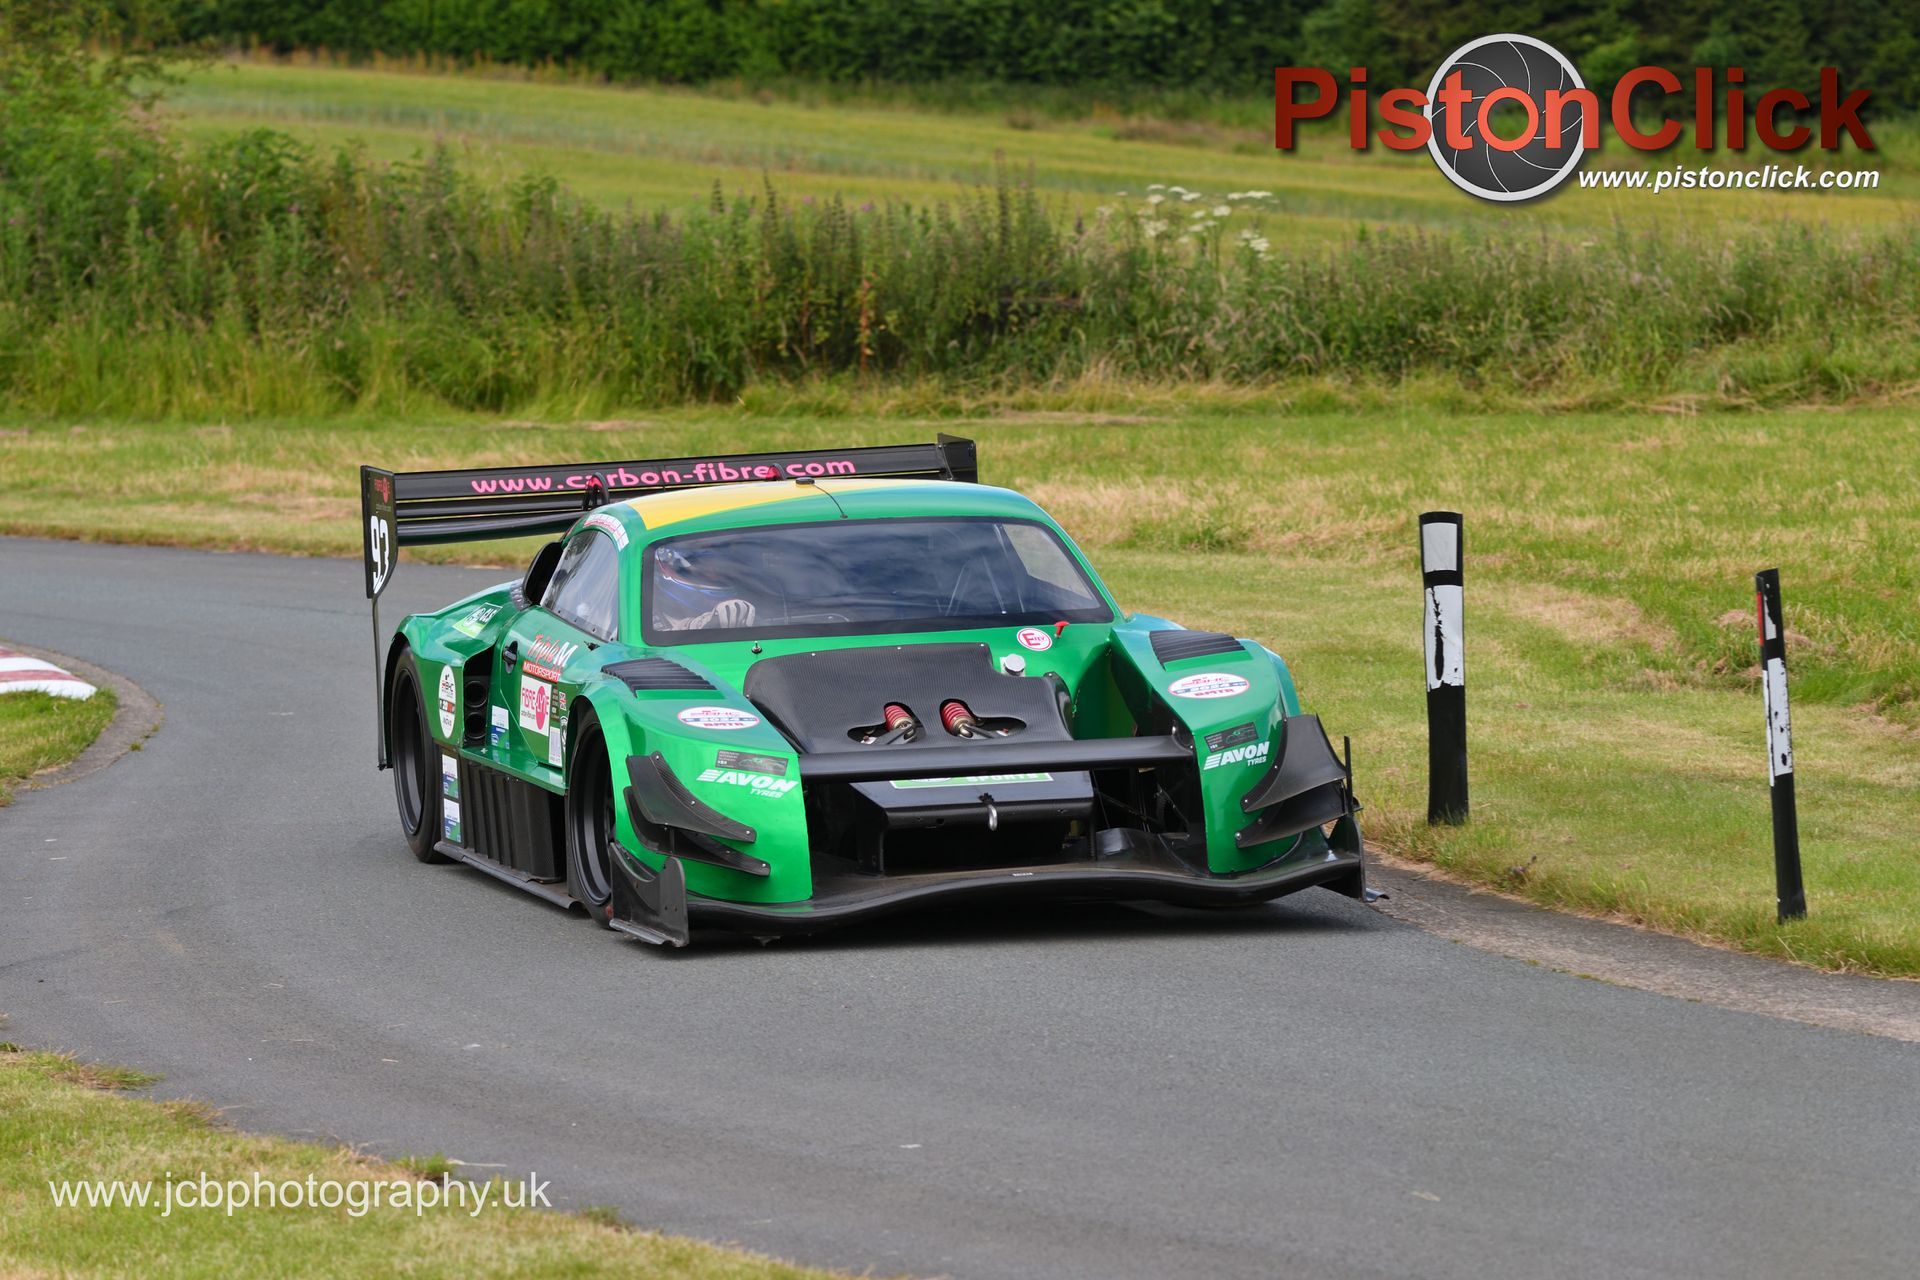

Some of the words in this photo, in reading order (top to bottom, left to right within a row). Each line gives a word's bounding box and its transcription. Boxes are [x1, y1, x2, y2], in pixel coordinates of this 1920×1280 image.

[471, 459, 856, 494] www.crbon-fibrecom
[371, 515, 389, 594] 93
[523, 661, 561, 682] MOTORSPORT
[1221, 741, 1270, 765] AVON
[1248, 756, 1267, 766] TYRES
[716, 771, 799, 792] AVON
[750, 788, 785, 799] TYRES
